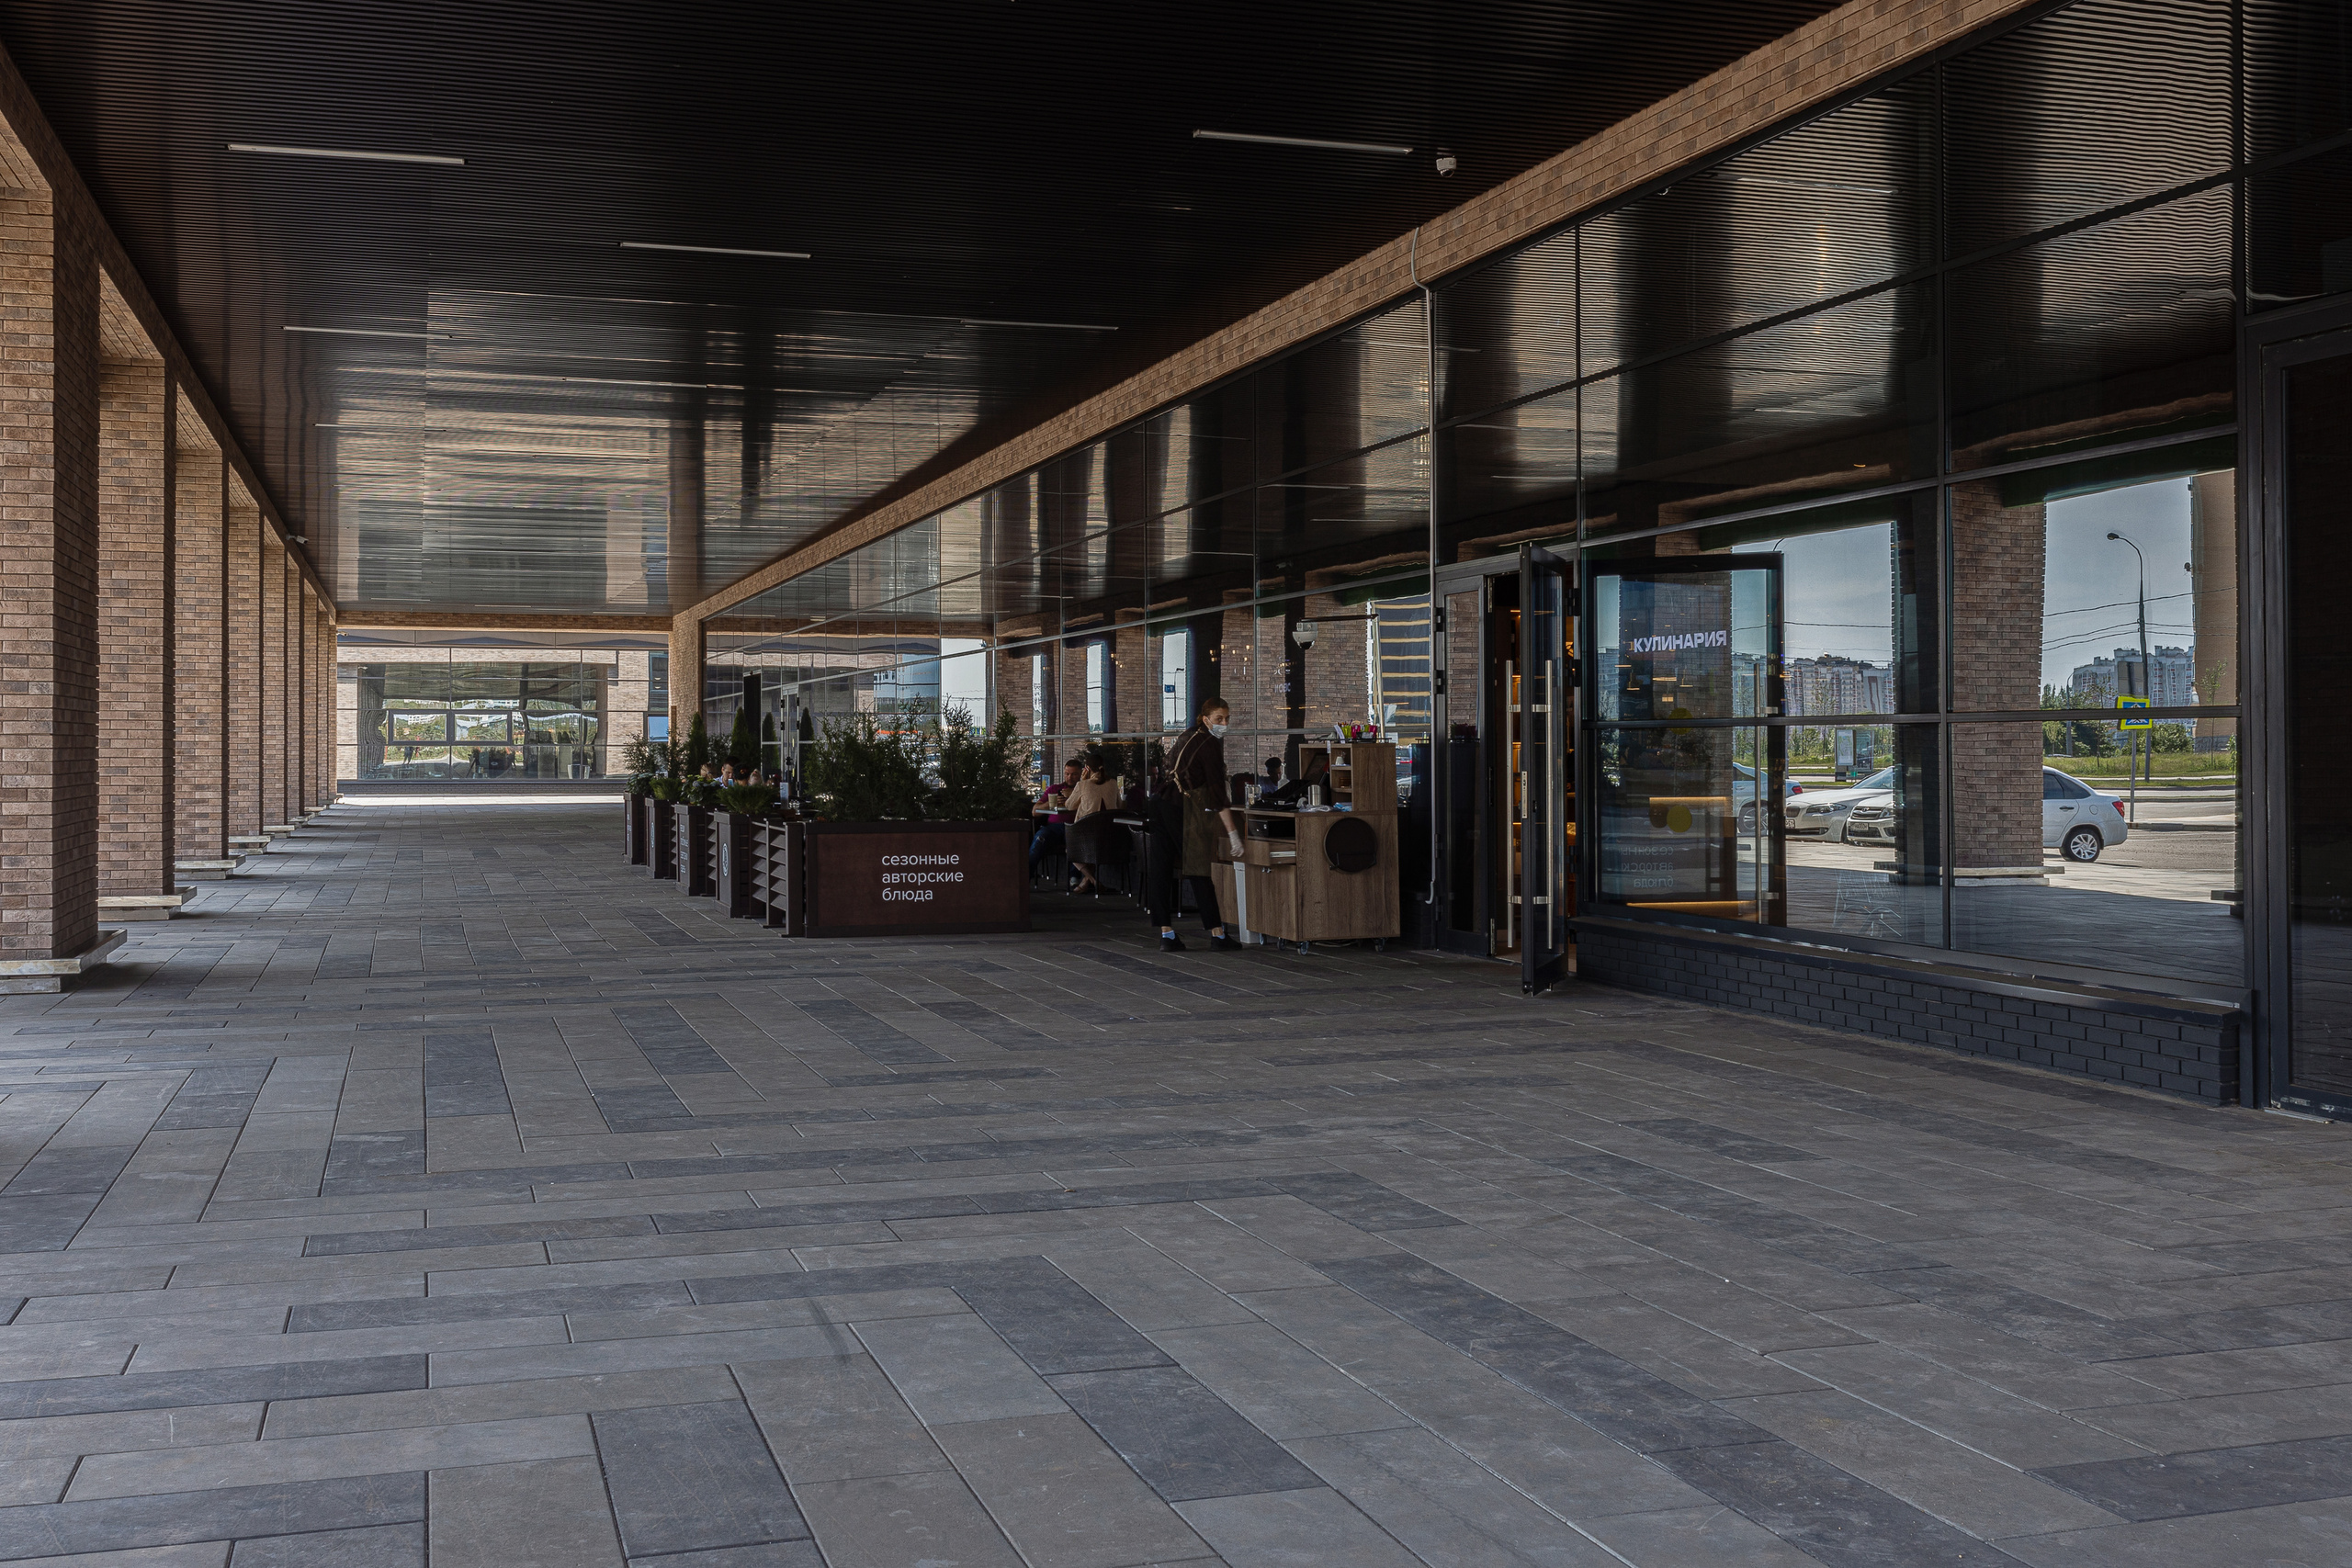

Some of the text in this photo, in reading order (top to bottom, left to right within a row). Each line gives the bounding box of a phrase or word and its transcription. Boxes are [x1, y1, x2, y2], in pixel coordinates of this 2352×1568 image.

[1634, 630, 1727, 653] КУЛИНАРИЯ
[881, 853, 960, 866] сезонные
[881, 871, 965, 886] авторские
[882, 887, 933, 902] блюда
